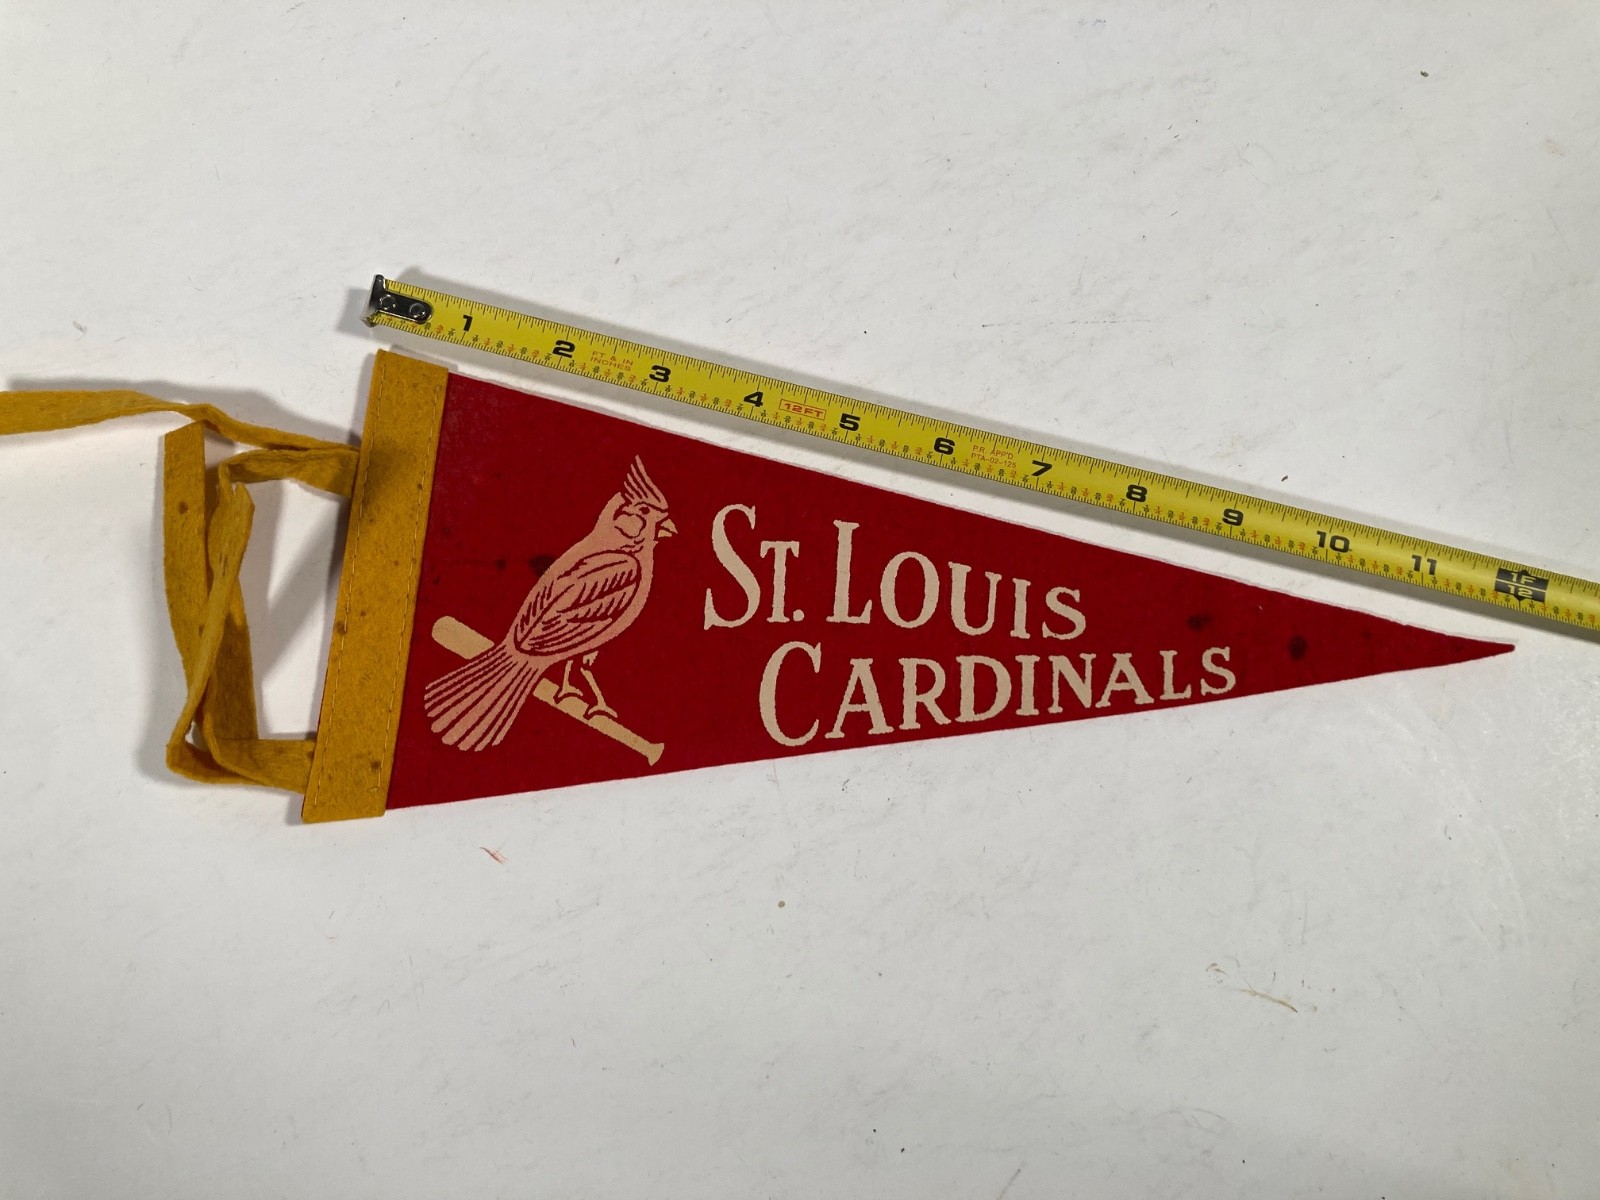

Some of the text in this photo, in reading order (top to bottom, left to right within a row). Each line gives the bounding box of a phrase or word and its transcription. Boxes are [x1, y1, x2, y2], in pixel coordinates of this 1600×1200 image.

[463, 314, 473, 331] 1
[552, 340, 575, 358] 2
[591, 356, 632, 371] INCHES
[649, 365, 671, 382] 3
[743, 391, 764, 408] 4
[783, 402, 824, 418] 12FT
[839, 413, 861, 431] 5
[933, 437, 956, 455] 6
[1031, 460, 1052, 476] 7
[1126, 484, 1148, 503] 8
[1222, 508, 1244, 526] 9
[1316, 530, 1351, 553] 10
[1411, 554, 1437, 576] 11
[825, 519, 1086, 640] LOUIS
[1510, 572, 1536, 585] 1F
[1508, 585, 1533, 598] 12
[759, 640, 1236, 746] CARDINALS
